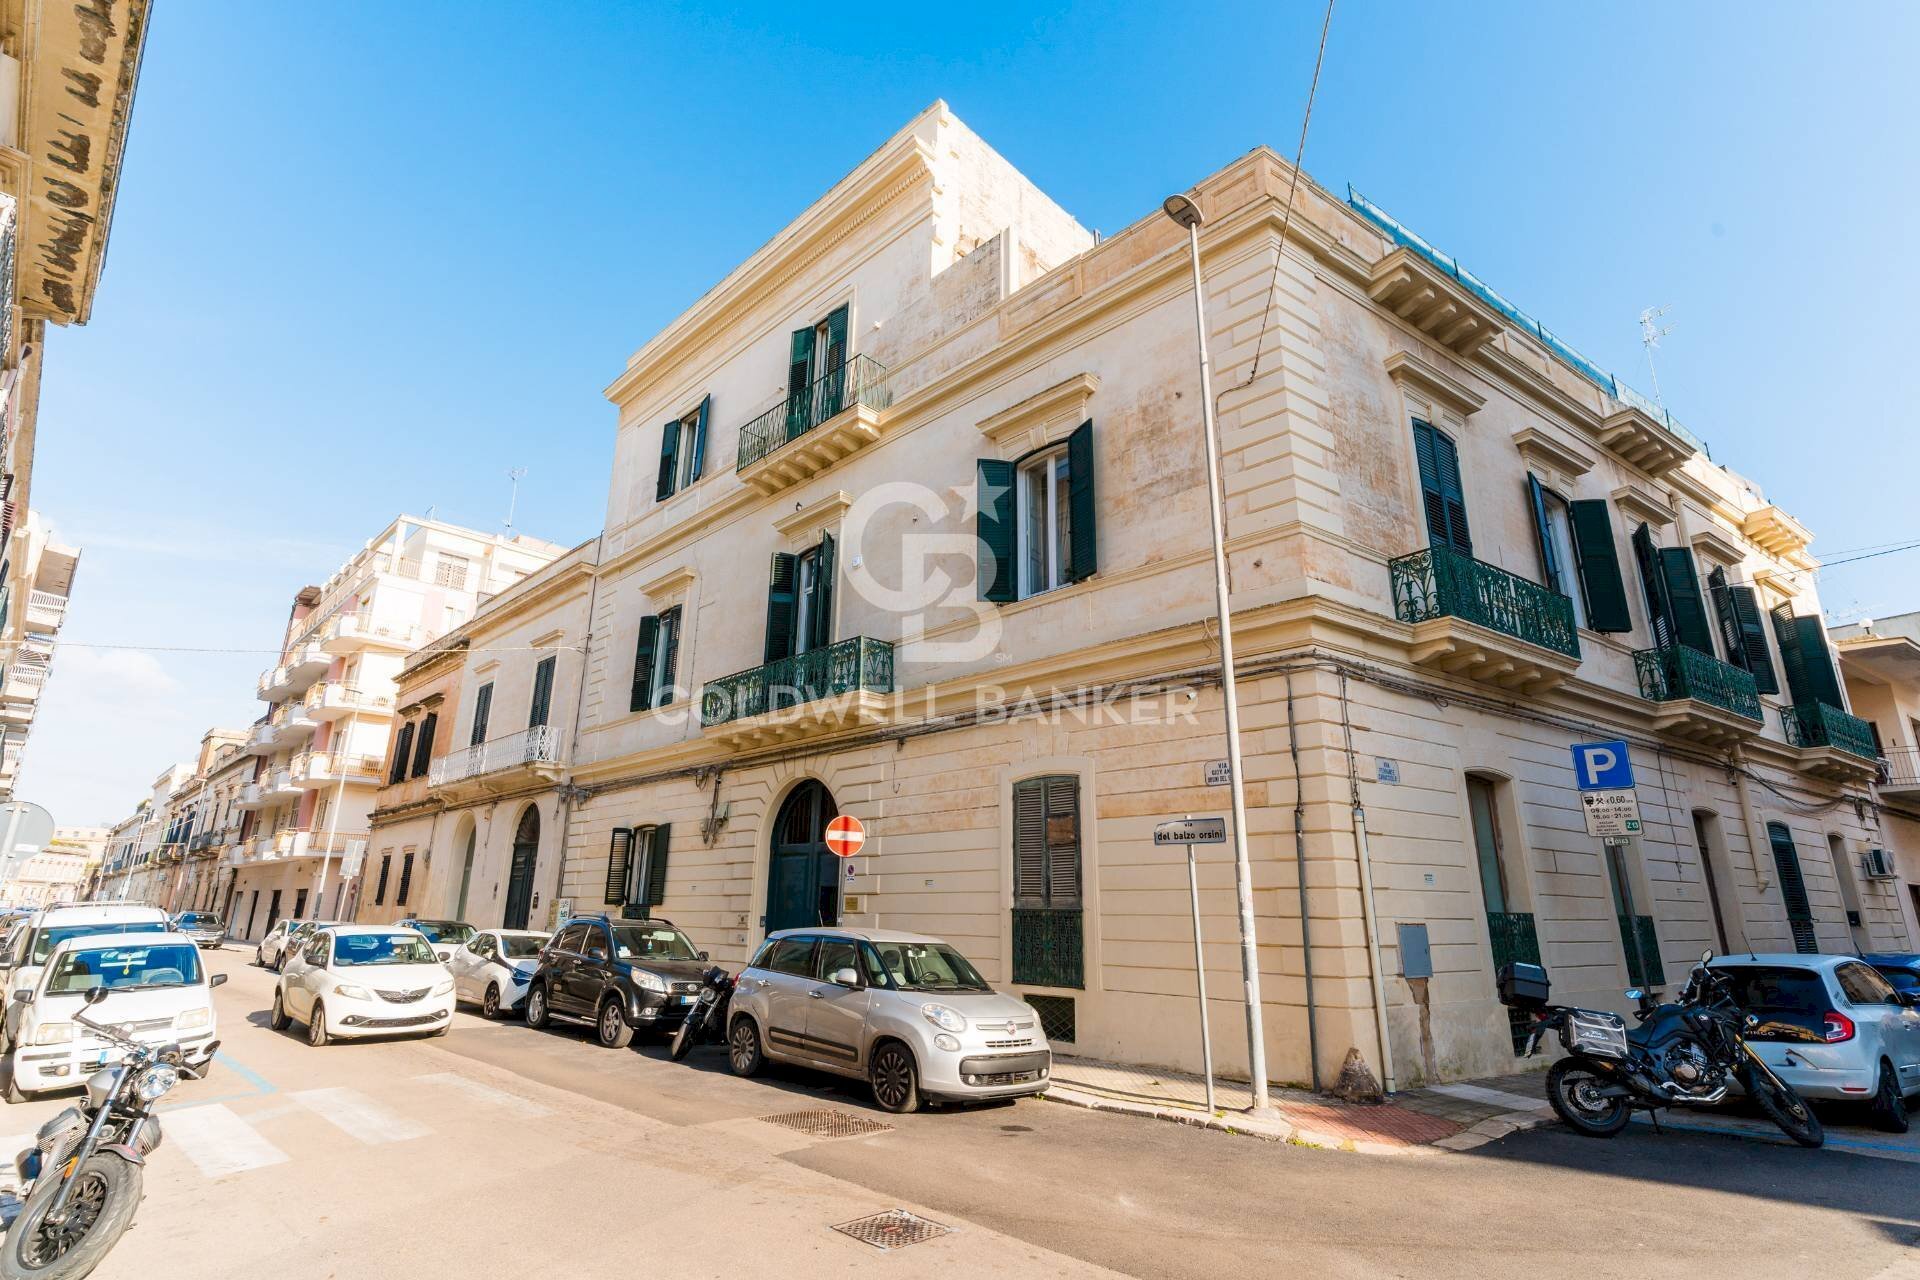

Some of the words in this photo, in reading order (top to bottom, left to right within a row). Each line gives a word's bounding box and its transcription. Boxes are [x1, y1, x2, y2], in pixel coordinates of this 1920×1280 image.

[1583, 748, 1617, 784] P
[1158, 832, 1170, 841] del
[1174, 830, 1195, 840] balzo
[1199, 830, 1222, 839] orsini
